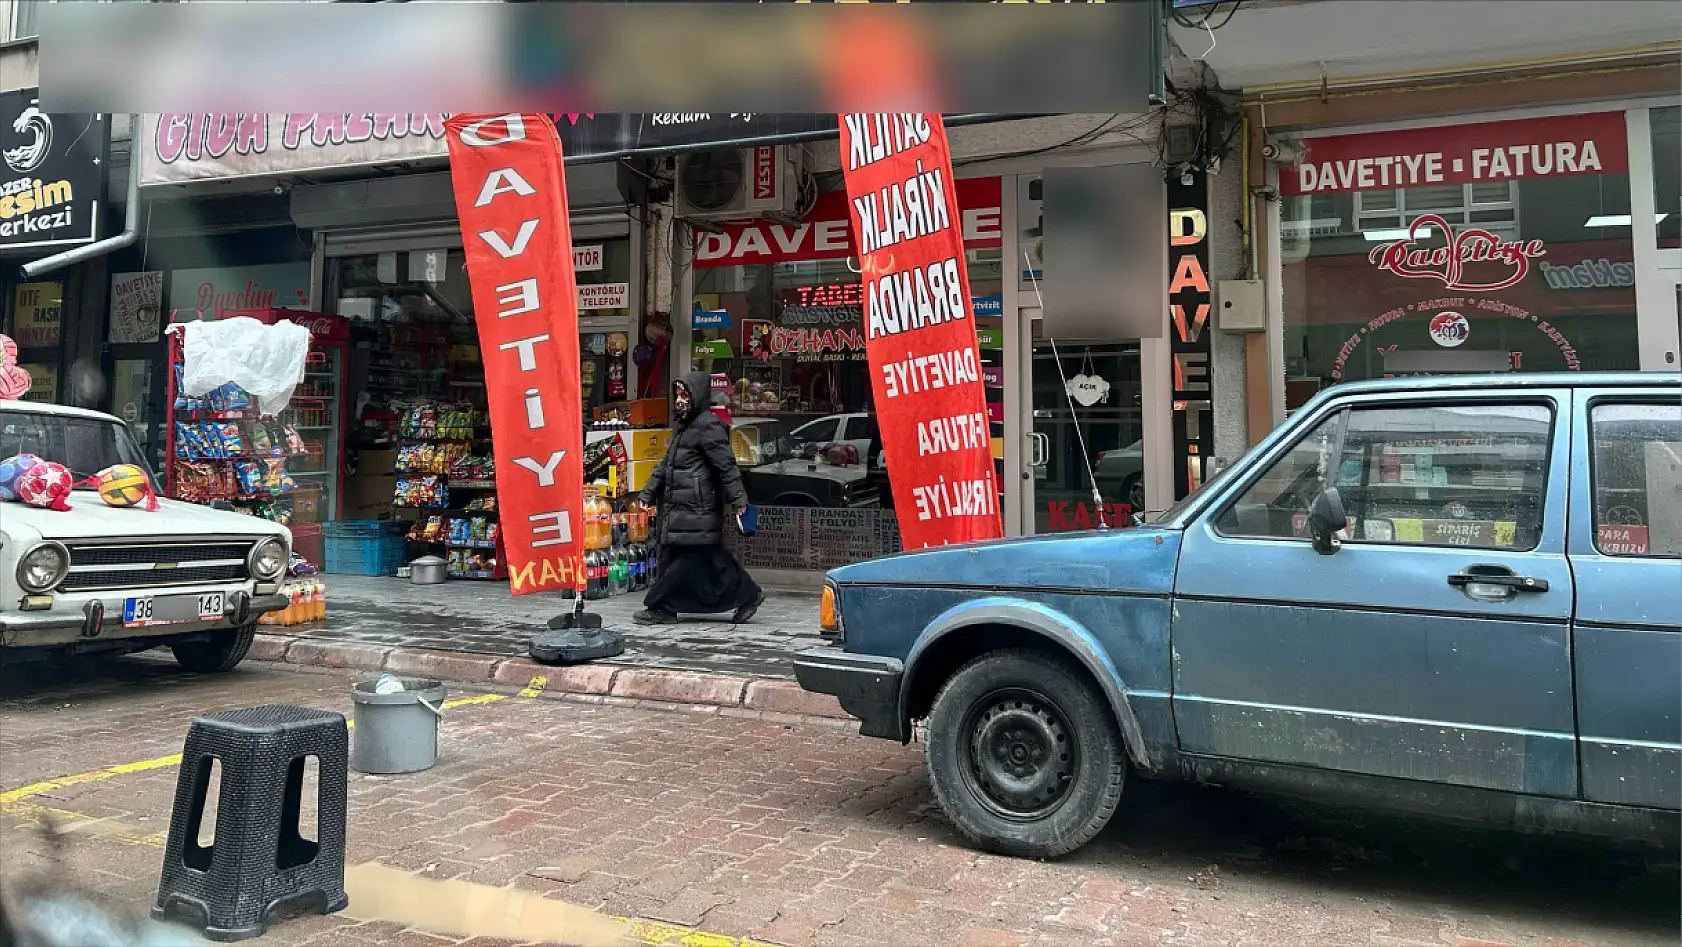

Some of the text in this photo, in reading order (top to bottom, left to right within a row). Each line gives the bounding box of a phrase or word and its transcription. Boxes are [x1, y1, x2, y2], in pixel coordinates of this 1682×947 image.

[1472, 140, 1602, 179] FATURA
[695, 315, 722, 324] Branda
[199, 594, 221, 614] 143
